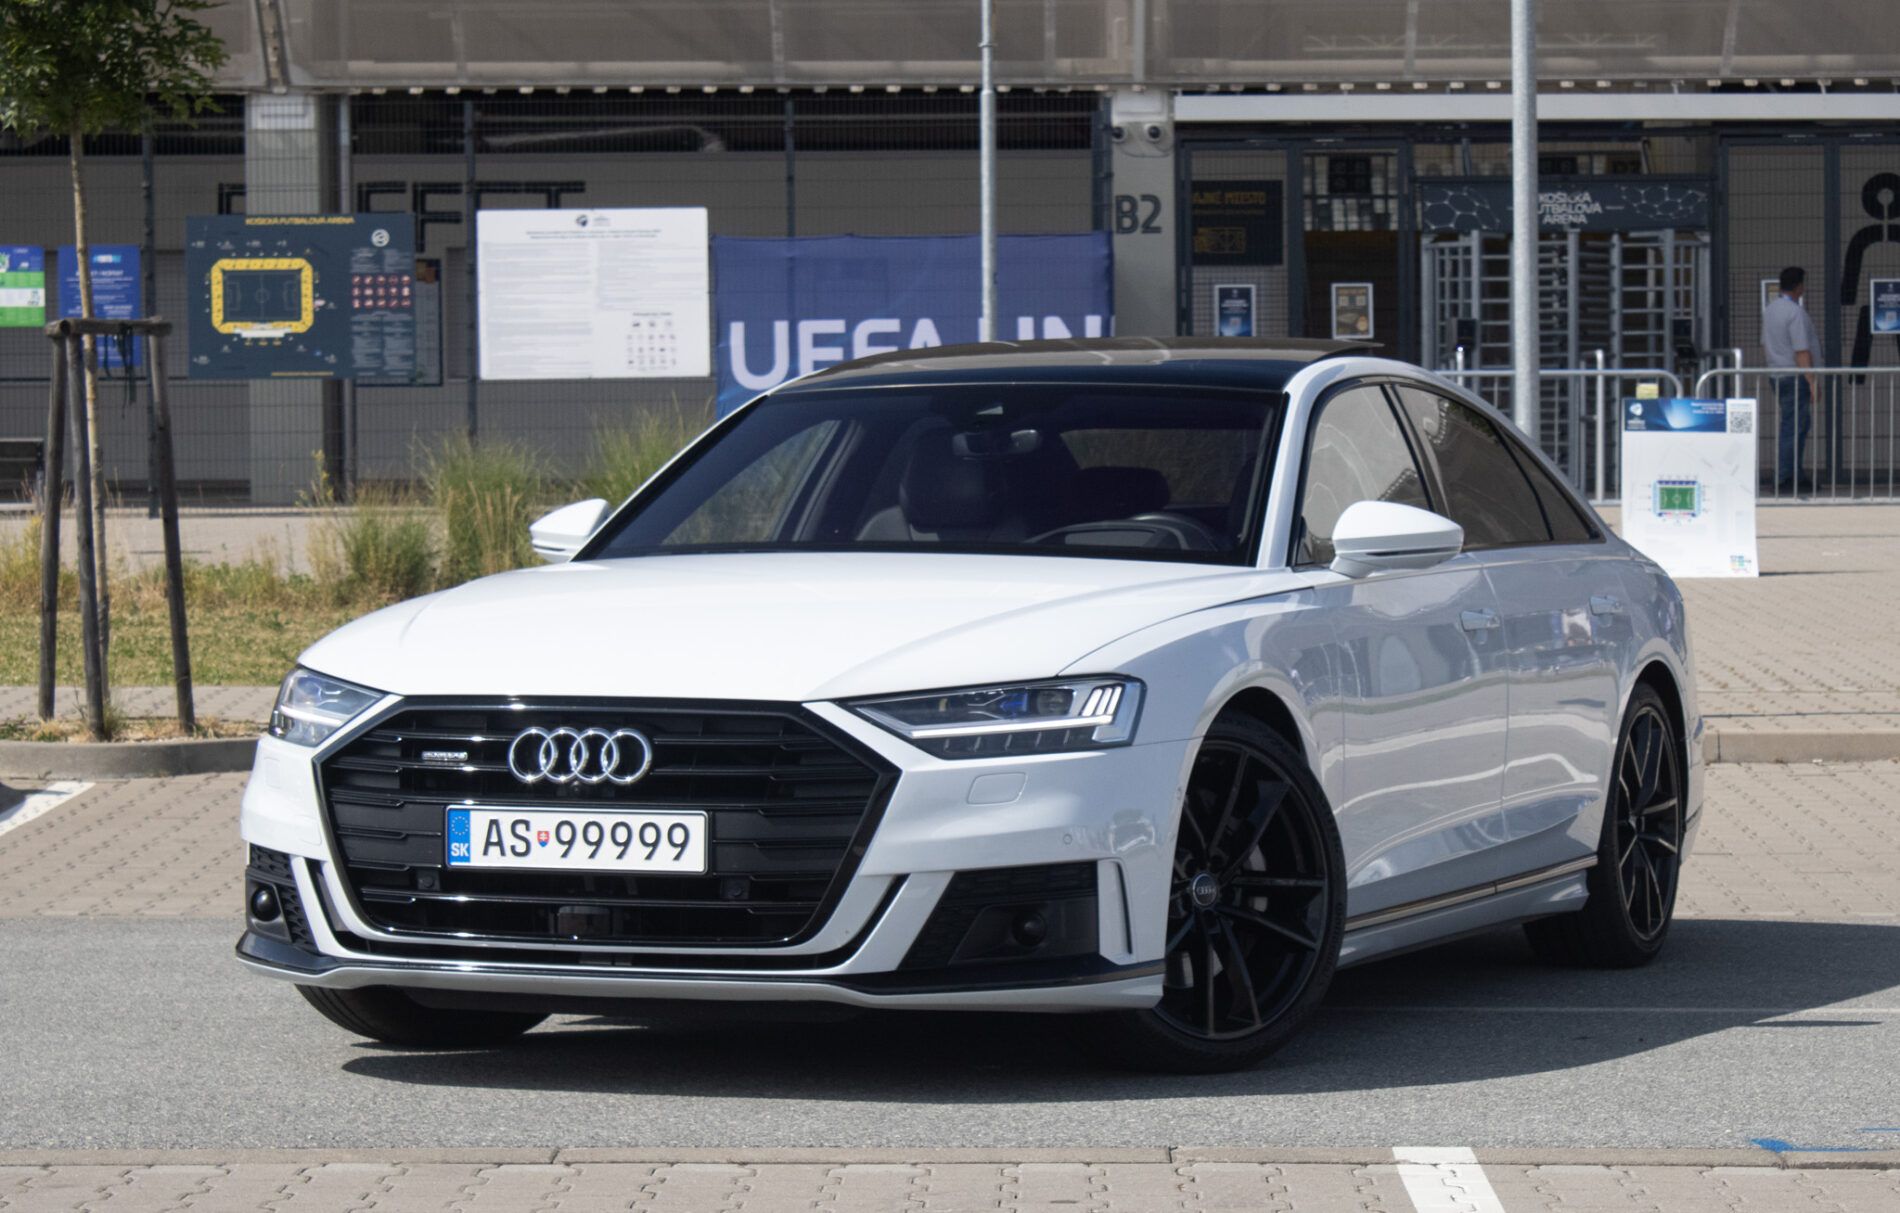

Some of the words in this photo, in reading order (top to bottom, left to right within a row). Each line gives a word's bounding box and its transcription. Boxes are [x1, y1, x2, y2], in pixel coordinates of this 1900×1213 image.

[1115, 194, 1162, 235] B2
[451, 842, 470, 857] SK
[482, 818, 532, 858] AS
[555, 820, 690, 862] 99999
